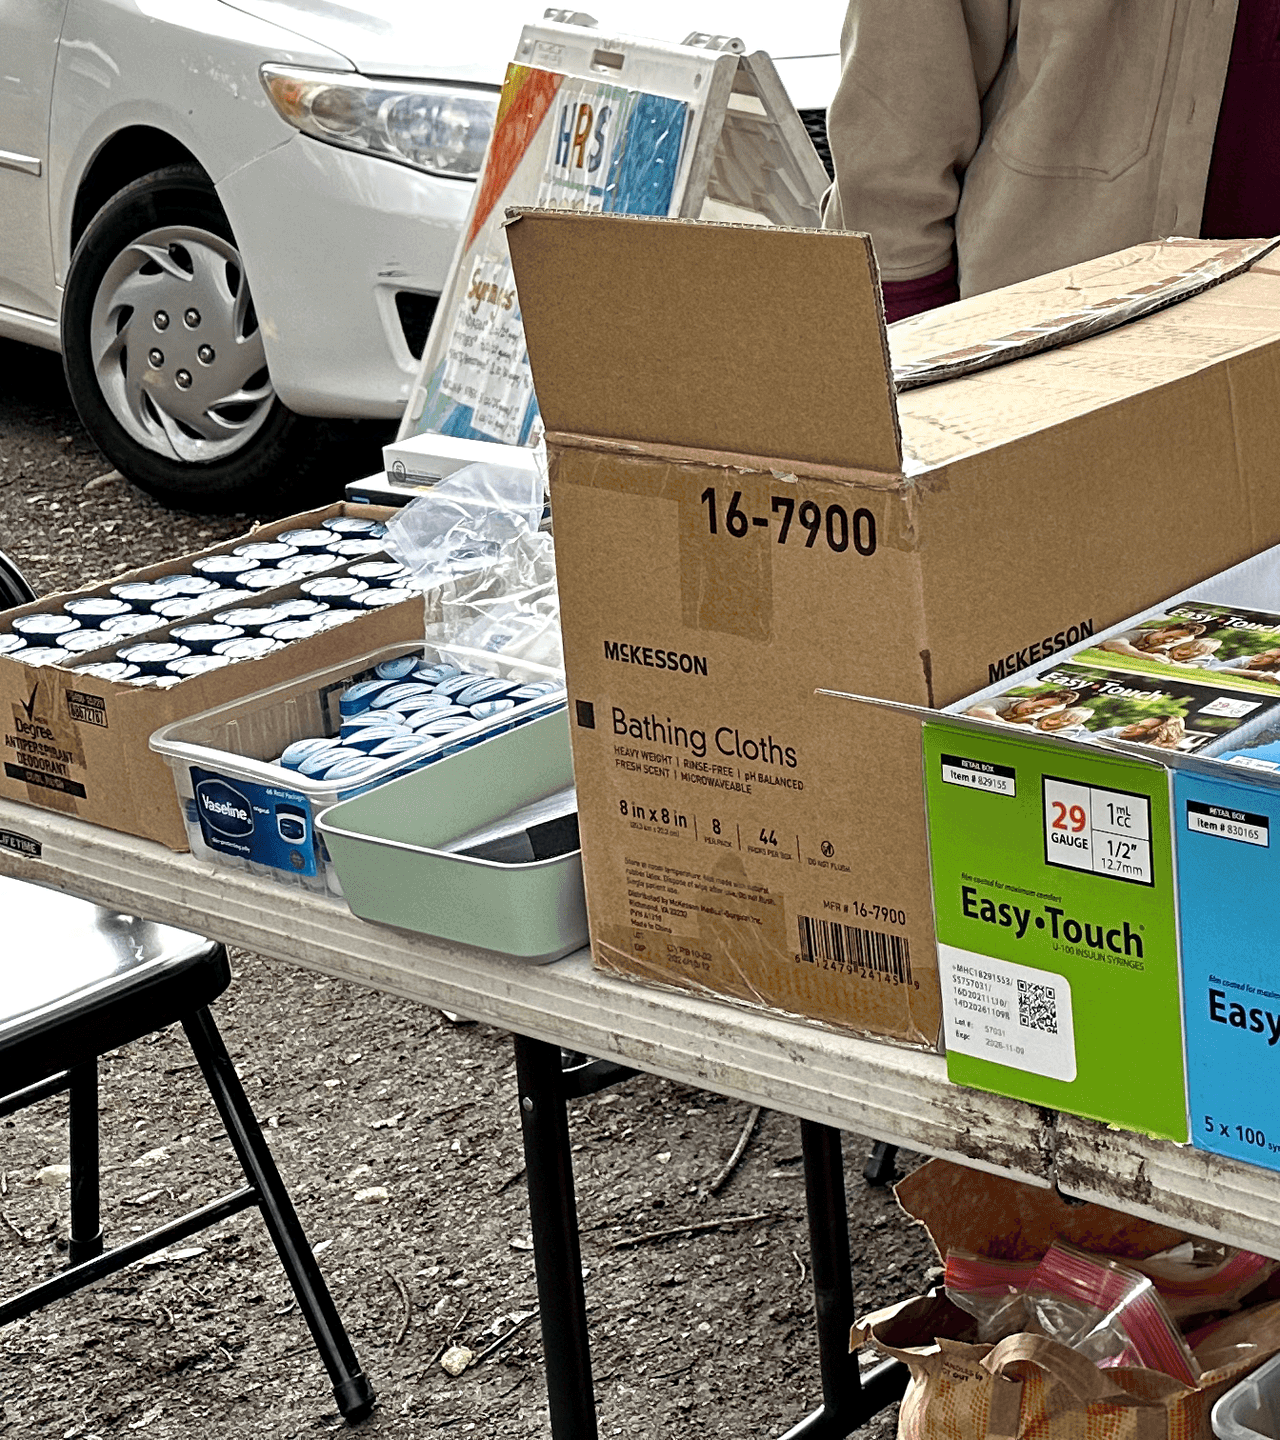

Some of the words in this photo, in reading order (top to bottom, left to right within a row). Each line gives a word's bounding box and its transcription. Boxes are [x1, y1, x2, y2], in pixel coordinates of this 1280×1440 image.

[701, 487, 877, 557] 16-7900
[1167, 608, 1218, 626] Easy
[1040, 671, 1093, 691] Easy
[1098, 680, 1166, 702] Touch
[15, 717, 55, 740] Degree
[612, 706, 706, 758] Bathing
[715, 727, 798, 768] Cloths
[5, 735, 74, 764] ANTIPERSPIRANT
[17, 751, 69, 777] DEODORANT
[614, 745, 639, 760] HEAVY
[641, 751, 673, 765] WEIGHT
[684, 759, 734, 778] RINSE-FREE
[758, 773, 804, 791] BALANCED
[616, 759, 641, 772] FRESH
[643, 765, 670, 778] SCENT
[681, 772, 752, 795] MICROWAVEABLE
[950, 770, 970, 783] Item
[977, 775, 1007, 790] 829155
[201, 793, 247, 820] Vaseline
[620, 799, 629, 816] 8
[632, 802, 645, 821] in
[661, 807, 670, 825] 8
[674, 810, 687, 829] in
[1051, 801, 1086, 833] 29
[1107, 803, 1115, 825] 1
[1116, 806, 1131, 817] mL
[712, 818, 721, 835] 8
[1116, 816, 1131, 829] CC
[1197, 818, 1218, 830] Item
[1227, 825, 1259, 840] 830165
[1, 833, 37, 853] IFETIME
[759, 828, 778, 847] 44
[1051, 832, 1089, 850] GAUGE
[1107, 840, 1137, 860] 1/2"
[1101, 858, 1143, 877] 12.7mm
[853, 901, 906, 927] 16-7900
[961, 885, 1031, 939] Easy
[1045, 905, 1144, 958] Touch
[1053, 944, 1075, 956] U-100
[1075, 948, 1105, 963] INSULIN
[1107, 954, 1144, 971] SYRINGES
[1204, 1115, 1214, 1133] 5
[1219, 1123, 1230, 1137] x
[1235, 1125, 1265, 1147] 100
